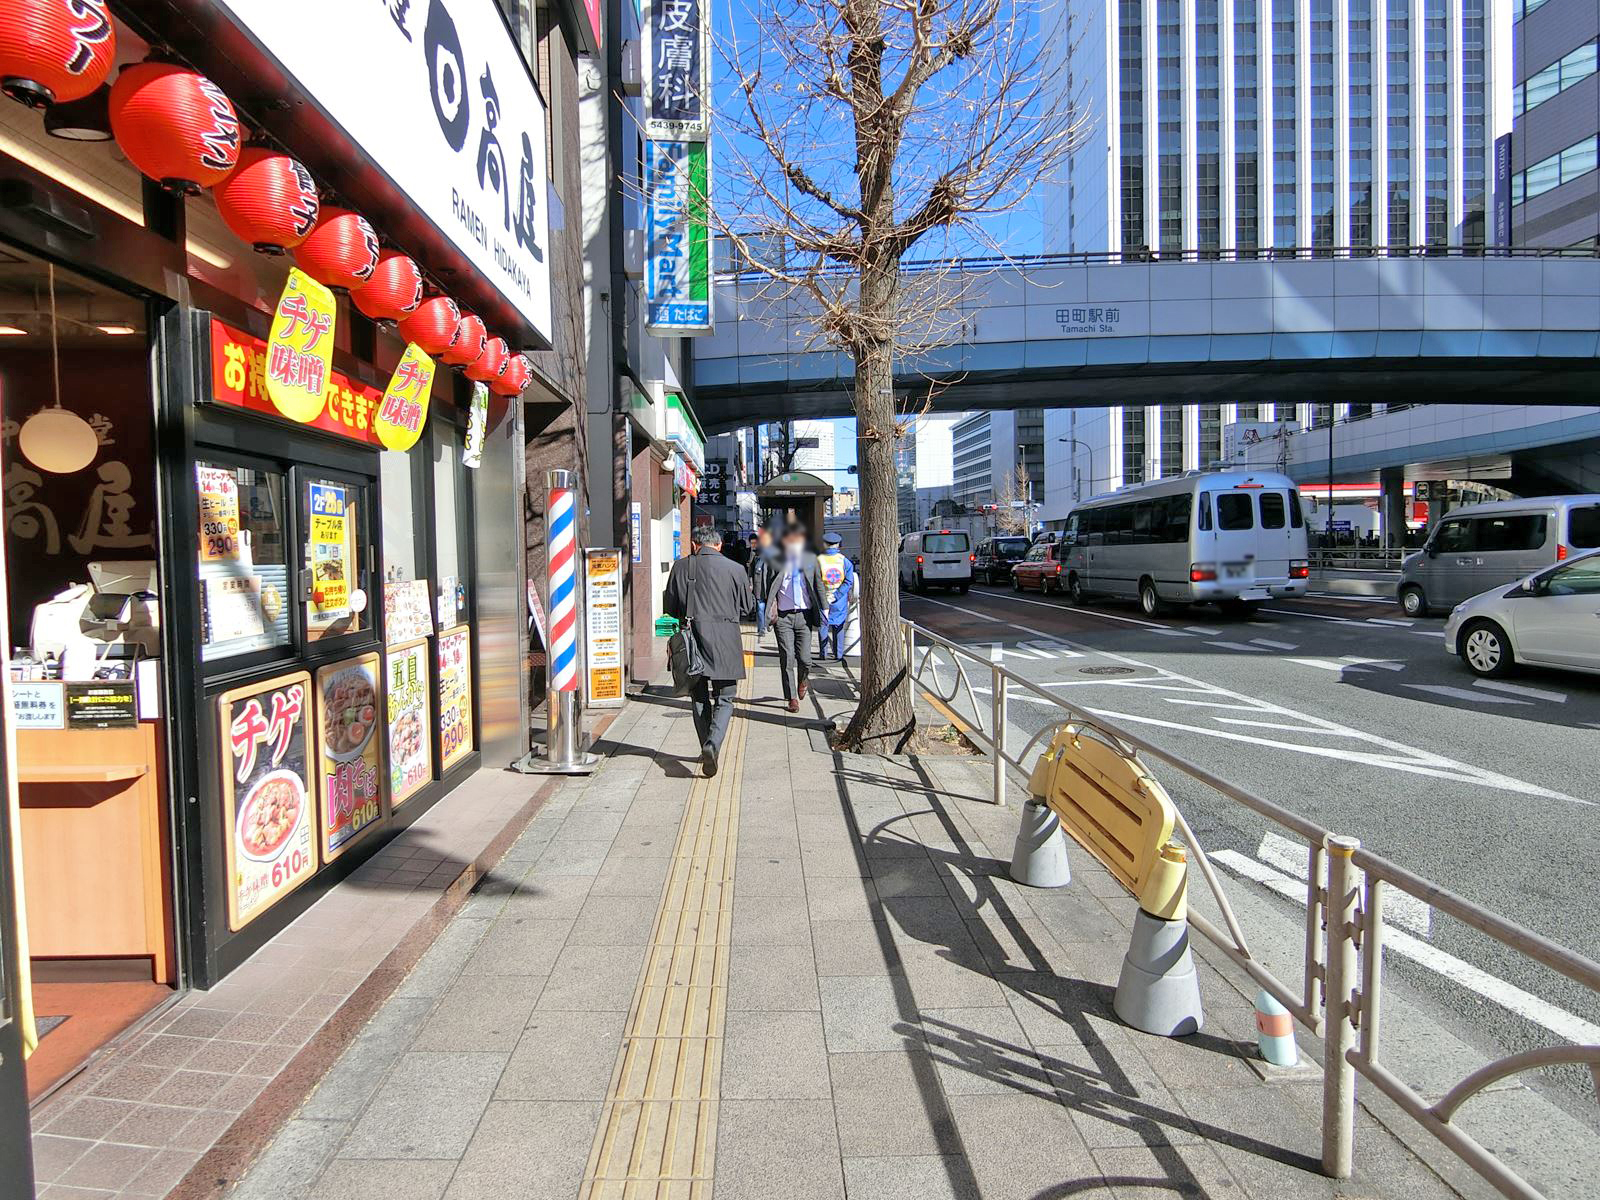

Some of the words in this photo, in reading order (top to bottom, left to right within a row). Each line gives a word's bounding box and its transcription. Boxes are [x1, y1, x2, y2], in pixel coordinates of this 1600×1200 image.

[658, 0, 694, 110] 皮膚科
[650, 121, 702, 131] 5439-9745
[452, 187, 488, 251] RAMEN
[494, 238, 531, 300] HIDAKAYA
[655, 142, 683, 298] FamilyMart
[279, 293, 331, 352] チゲ
[655, 305, 669, 322] 酒
[674, 306, 704, 322] たばこ
[1056, 308, 1120, 323] 田町駅前
[1061, 325, 1096, 333] Tamachi
[231, 684, 303, 783] チゲ
